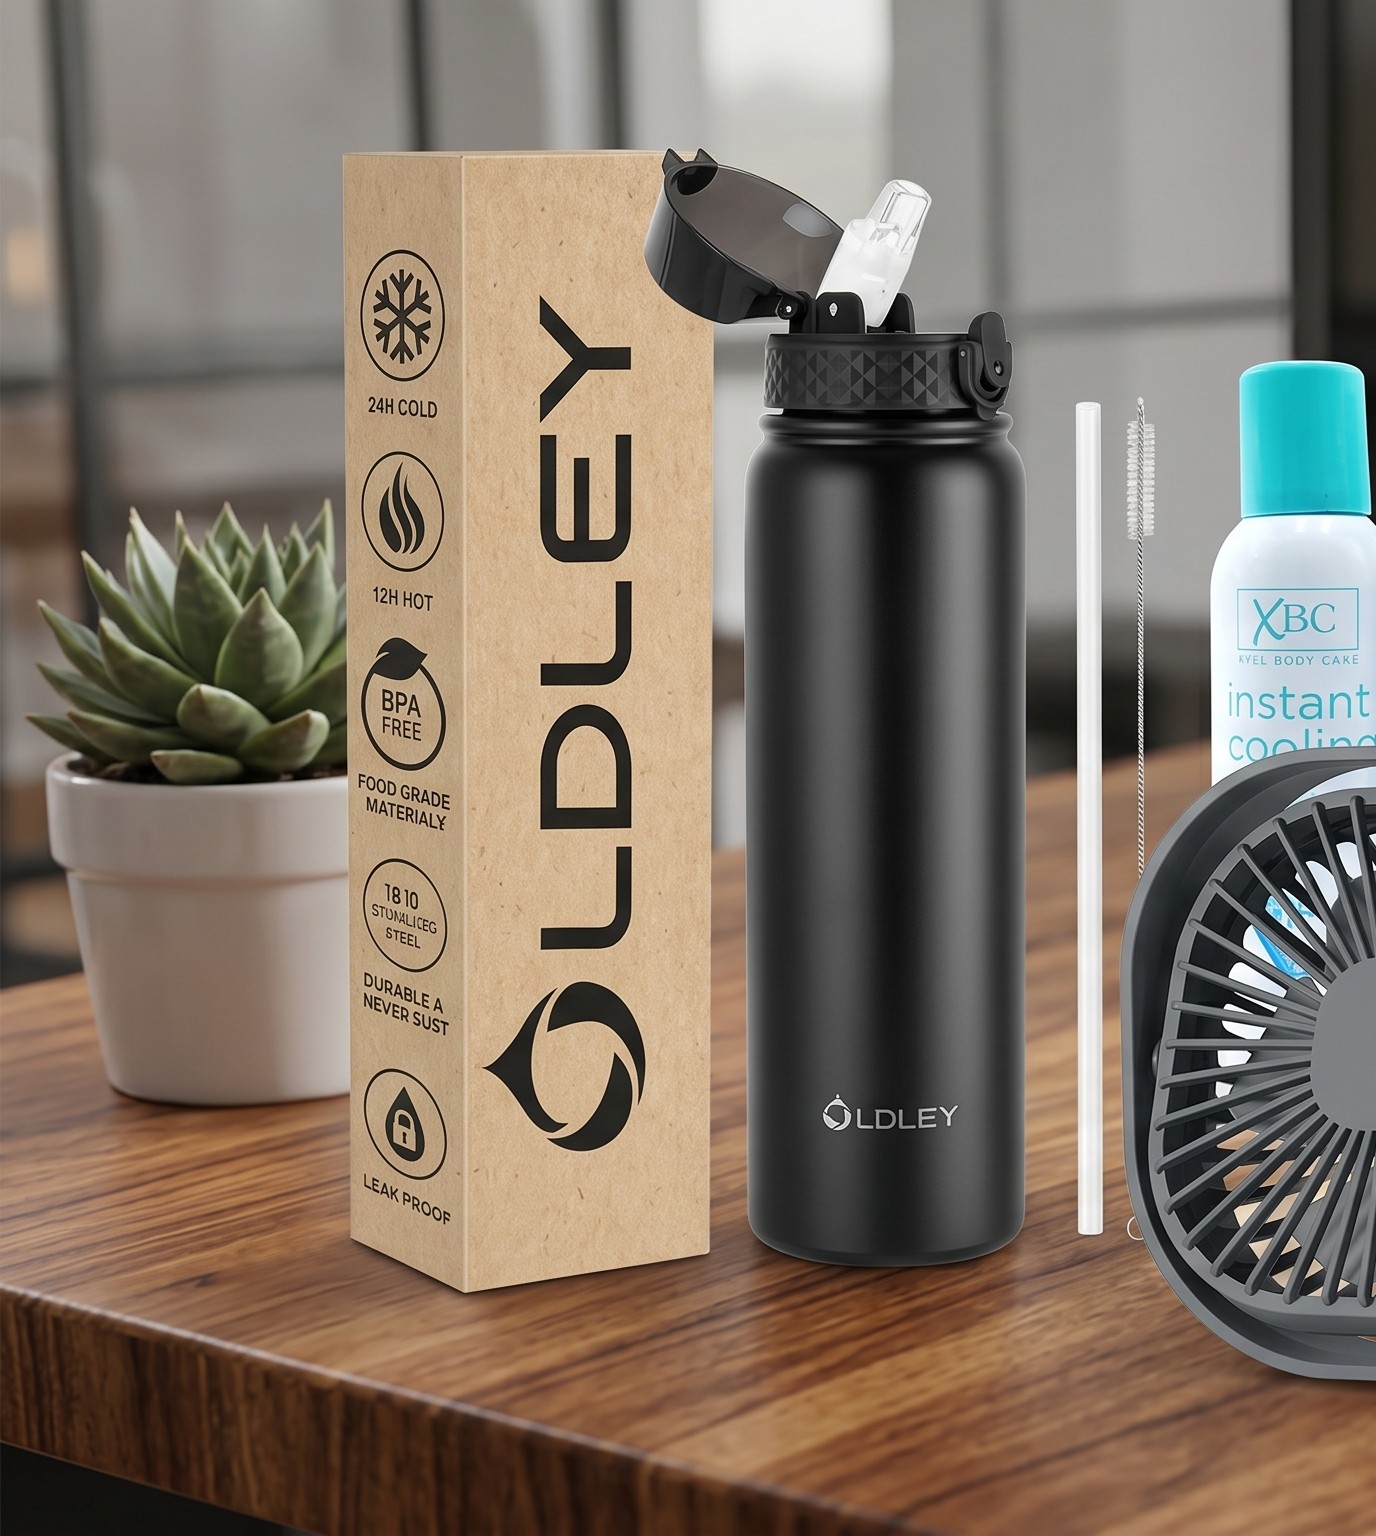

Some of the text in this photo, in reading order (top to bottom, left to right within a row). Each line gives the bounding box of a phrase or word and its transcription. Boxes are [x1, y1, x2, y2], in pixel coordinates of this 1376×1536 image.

[368, 396, 438, 418] 24H COLD
[373, 586, 433, 611] 12H HOT
[1252, 597, 1336, 646] XBC
[1274, 655, 1314, 666] BODY
[381, 688, 422, 718] BPA
[1228, 682, 1370, 721] instant
[382, 716, 422, 742] FREE
[358, 773, 450, 810] FOOD GRADE
[385, 927, 421, 949] STEEL
[363, 972, 444, 1014] DURABLE A
[363, 992, 449, 1036] NEVER SUST
[363, 1173, 451, 1225] LEAK PROOF
